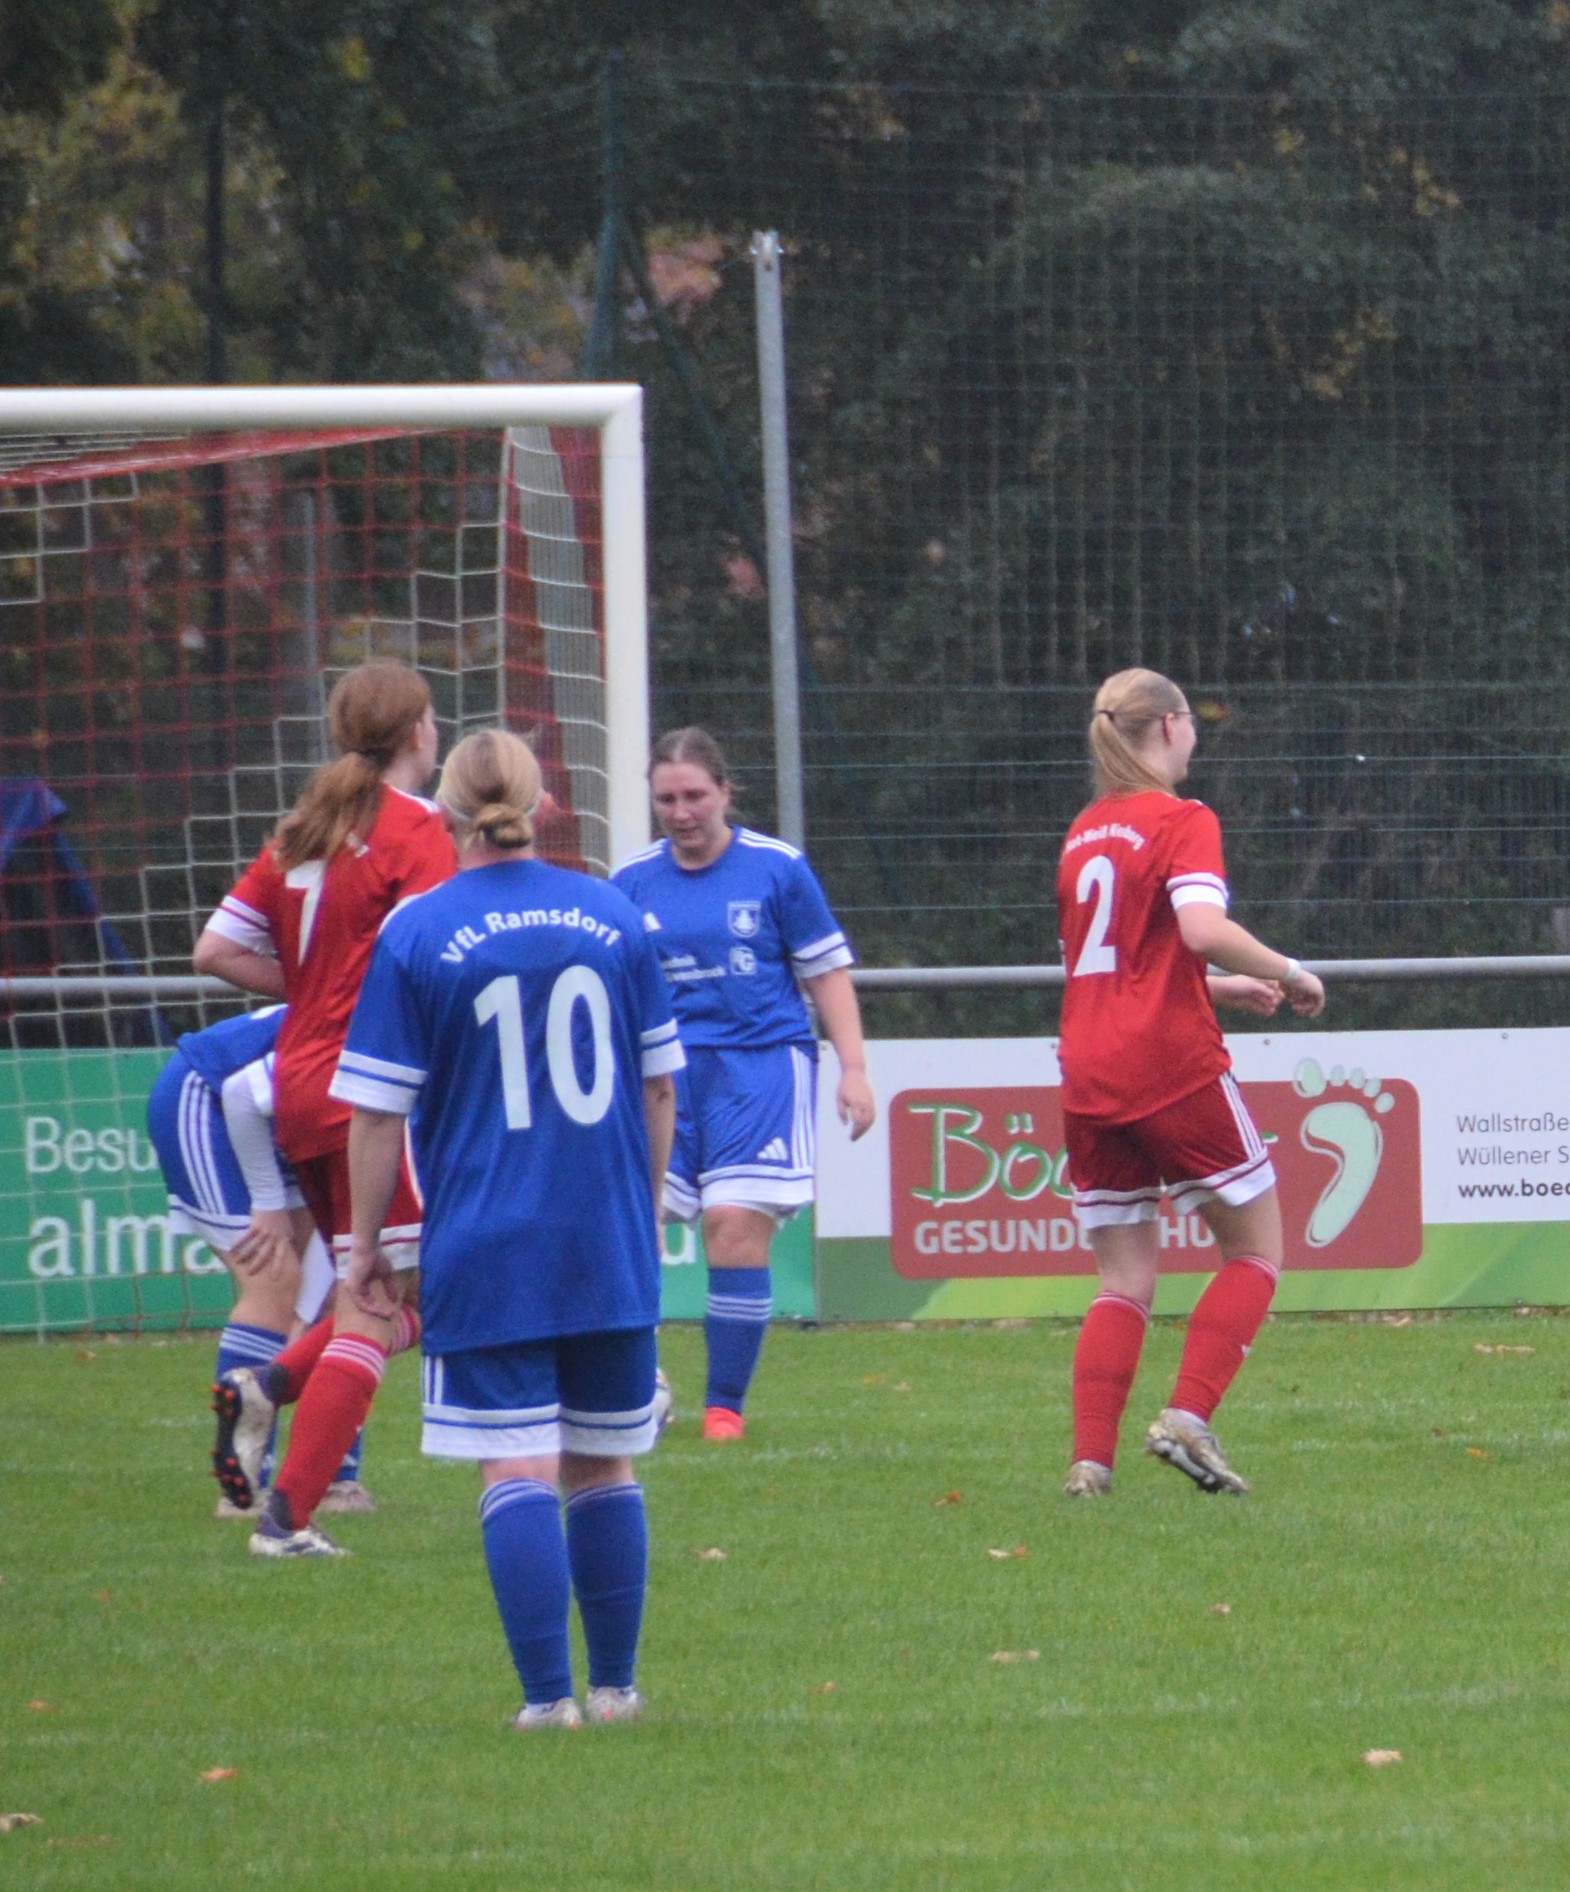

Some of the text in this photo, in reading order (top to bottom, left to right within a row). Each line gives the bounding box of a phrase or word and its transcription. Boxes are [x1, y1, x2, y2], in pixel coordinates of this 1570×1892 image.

[285, 858, 327, 966] 7
[439, 907, 621, 964] VfL Ramsdorf
[1072, 855, 1117, 977] 2
[473, 964, 615, 1131] 10
[26, 1116, 158, 1173] Besu
[1457, 1111, 1570, 1133] Wallstraße
[1457, 1146, 1550, 1166] Wüllener
